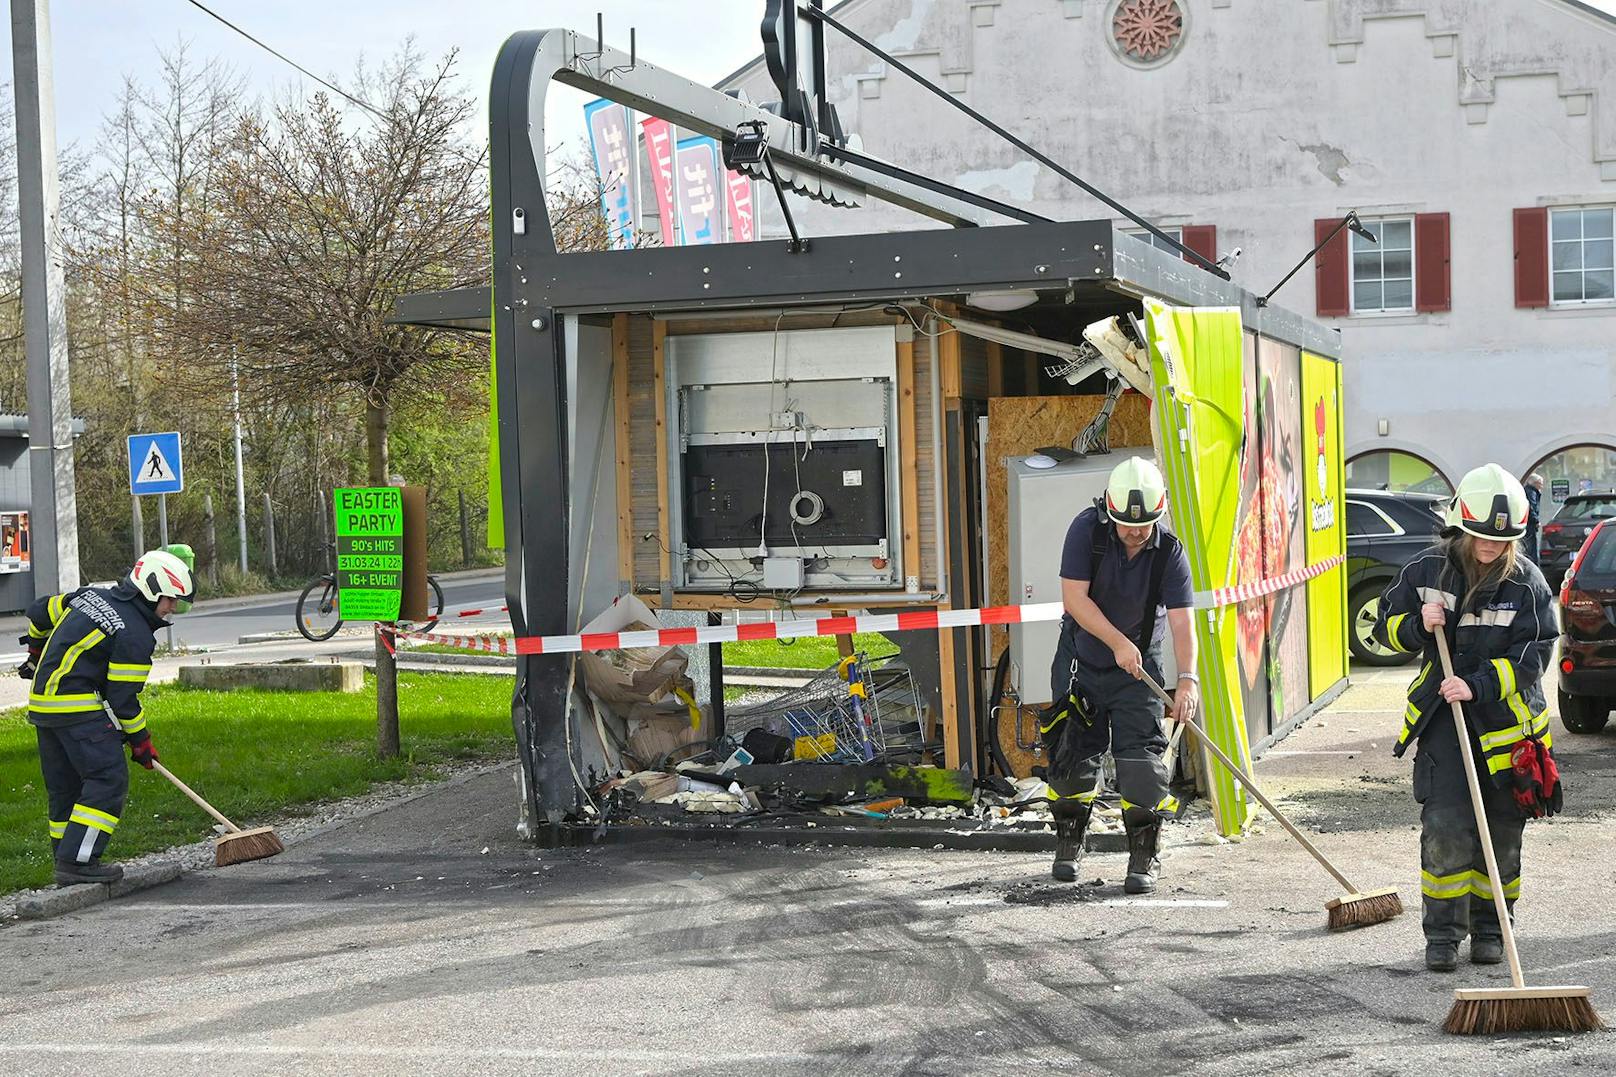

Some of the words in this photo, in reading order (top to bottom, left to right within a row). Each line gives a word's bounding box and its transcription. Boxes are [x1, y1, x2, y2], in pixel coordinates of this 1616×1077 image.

[342, 492, 399, 510] EASTER
[348, 514, 396, 531] PARTY
[351, 540, 373, 552] 90's
[374, 540, 395, 552] HITS
[341, 557, 380, 568] 31.03.24
[348, 573, 367, 586] 16+
[369, 573, 398, 586] EVENT
[80, 590, 126, 630] FEUERWEHR
